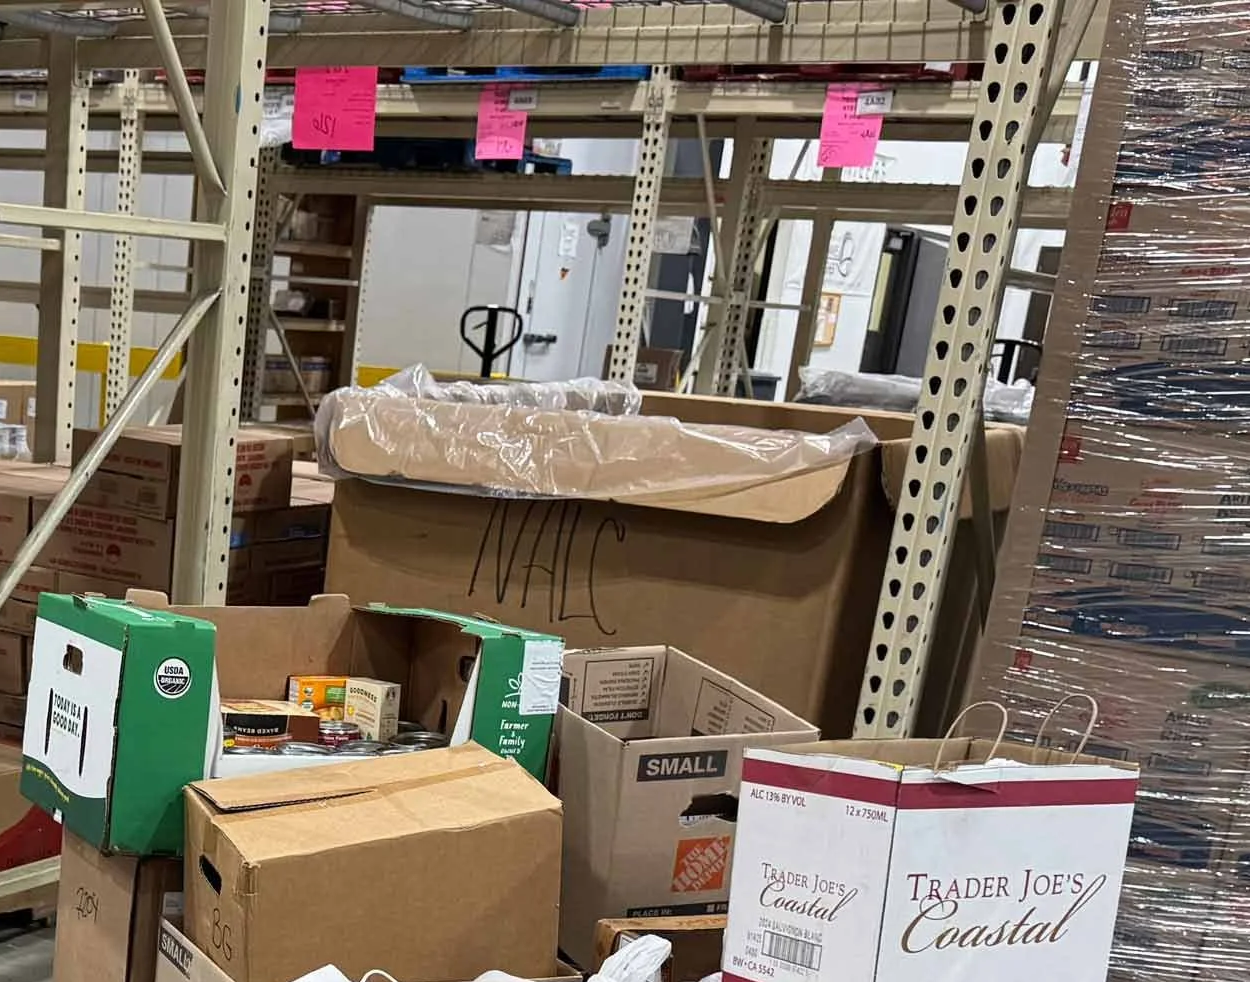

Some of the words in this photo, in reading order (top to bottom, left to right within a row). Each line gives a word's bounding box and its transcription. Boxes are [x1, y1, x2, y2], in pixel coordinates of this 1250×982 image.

[160, 676, 186, 685] ORGANIC
[164, 665, 184, 676] USDA
[54, 693, 71, 713] TODAY
[70, 703, 77, 715] IS
[76, 706, 82, 717] A
[52, 710, 68, 731] GOOD
[67, 721, 80, 738] DAY.
[500, 719, 529, 731] Farmer
[499, 735, 526, 749] Family
[646, 755, 718, 776] SMALL
[750, 788, 765, 800] ALC
[765, 791, 781, 802] 13%
[781, 794, 792, 805] BY
[791, 796, 806, 808] VOL
[845, 805, 855, 816] 12
[861, 808, 889, 823] 750ML
[671, 837, 727, 892] HOME
[761, 862, 809, 890] TRADER
[811, 874, 846, 897] JOE'S
[907, 873, 1010, 901] TRADER
[1018, 869, 1085, 902] JOE'S
[759, 879, 859, 923] Coastal
[901, 874, 1107, 954] Coastal
[757, 962, 775, 978] 5542
